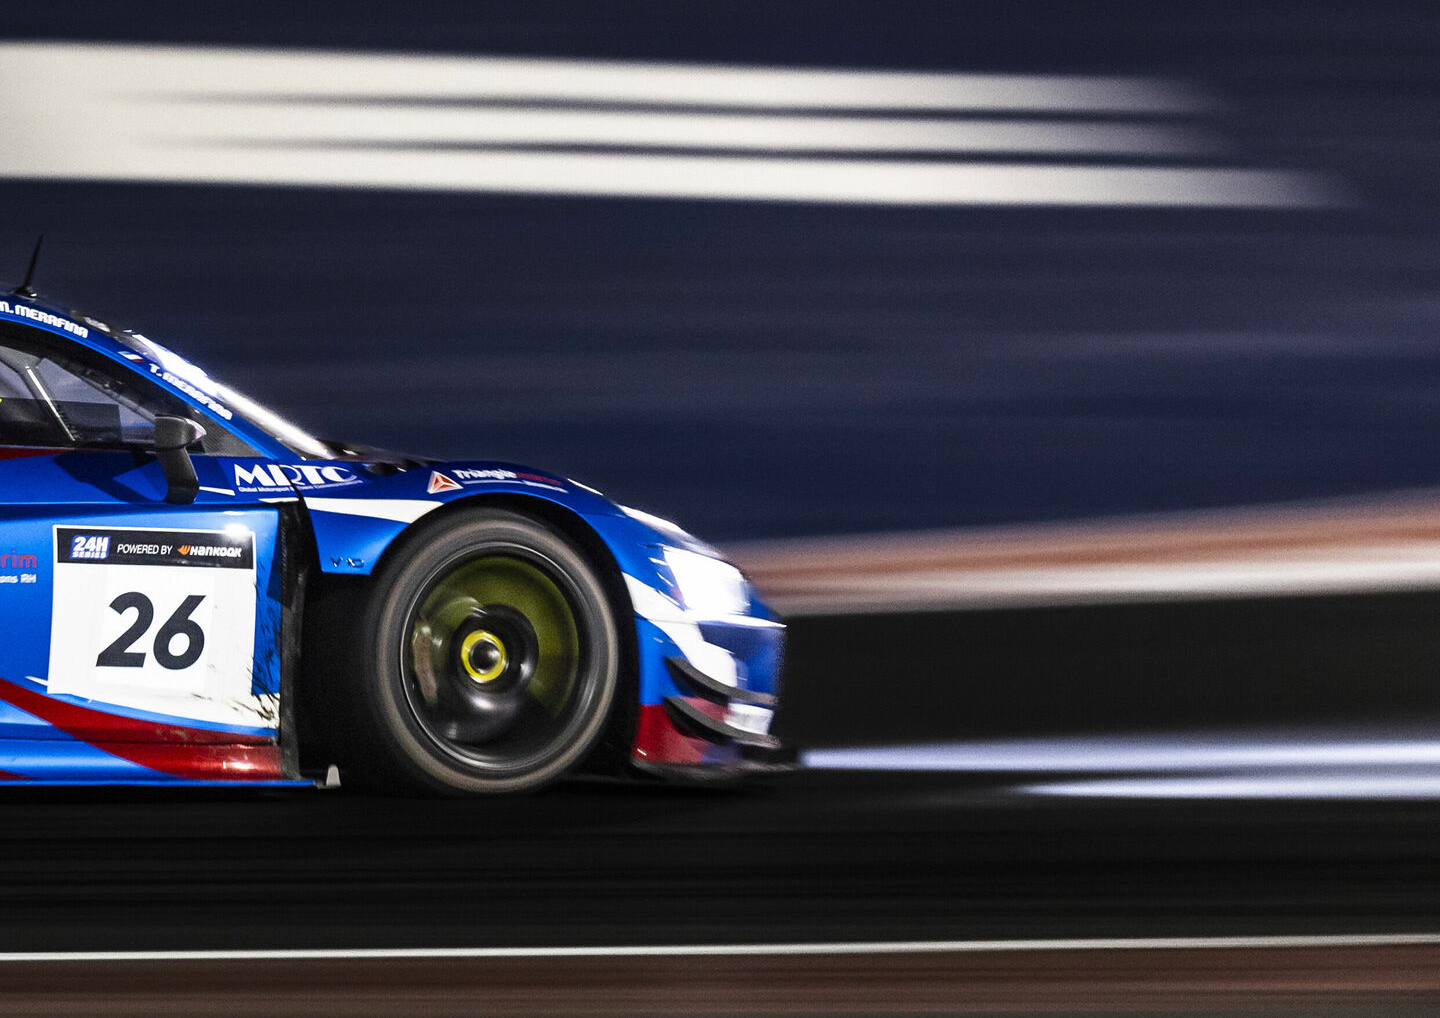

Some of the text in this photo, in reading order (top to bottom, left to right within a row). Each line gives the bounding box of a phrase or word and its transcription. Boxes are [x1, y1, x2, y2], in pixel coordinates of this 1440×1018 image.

[234, 463, 357, 486] MRTC
[73, 536, 109, 553] 24H
[117, 543, 159, 555] POWERED
[160, 544, 173, 555] BY
[95, 591, 208, 671] 26
